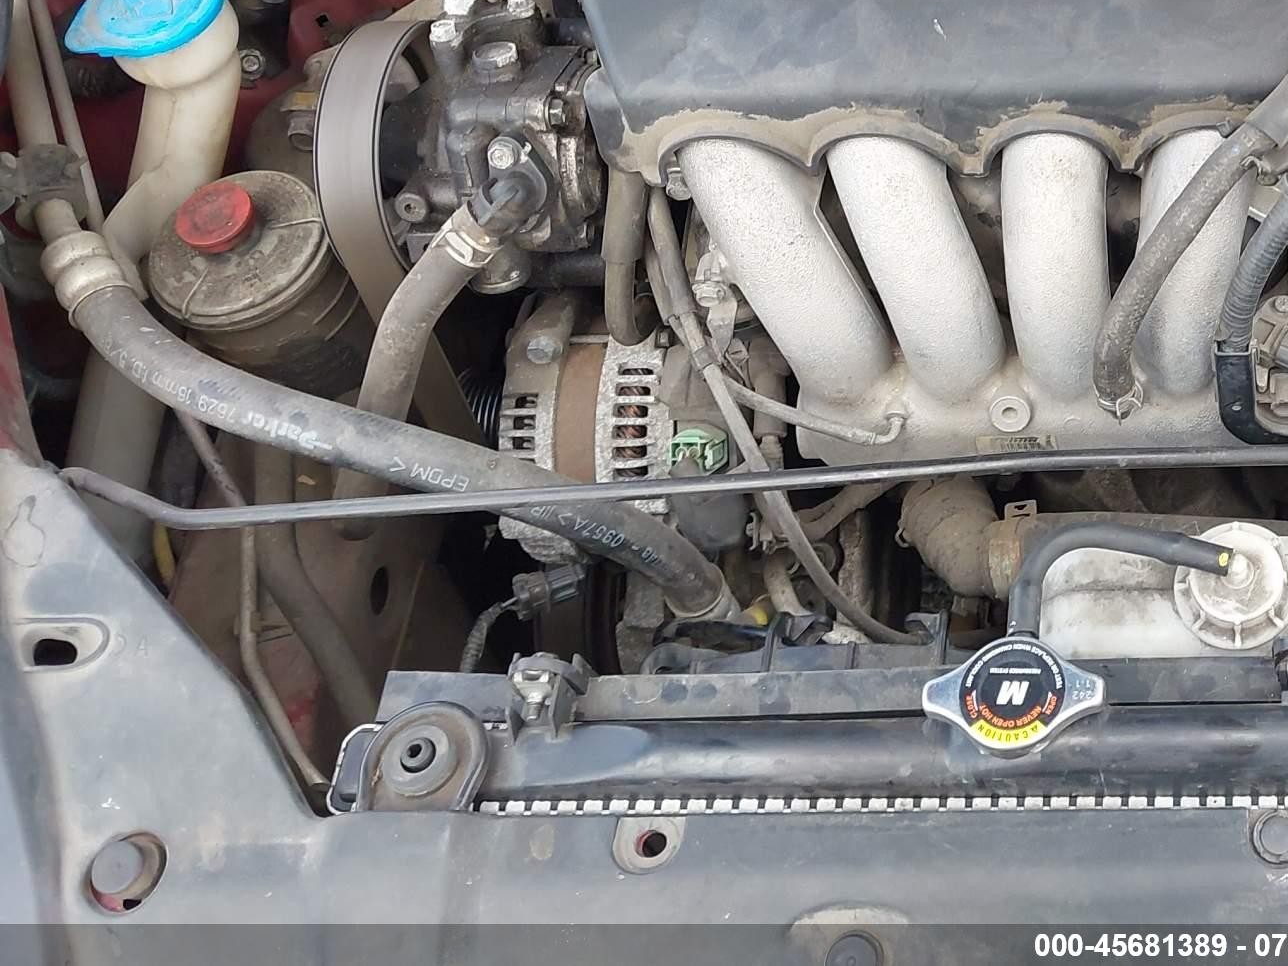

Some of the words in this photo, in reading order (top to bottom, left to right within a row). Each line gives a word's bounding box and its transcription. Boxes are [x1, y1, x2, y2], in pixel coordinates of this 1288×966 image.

[241, 411, 332, 451] Parker
[409, 462, 470, 492] EPDM
[996, 680, 1030, 705] M
[978, 704, 994, 720] HOT
[991, 716, 1015, 728] OPEN
[1015, 705, 1042, 726] NEVER
[977, 724, 1029, 742] CAUTION
